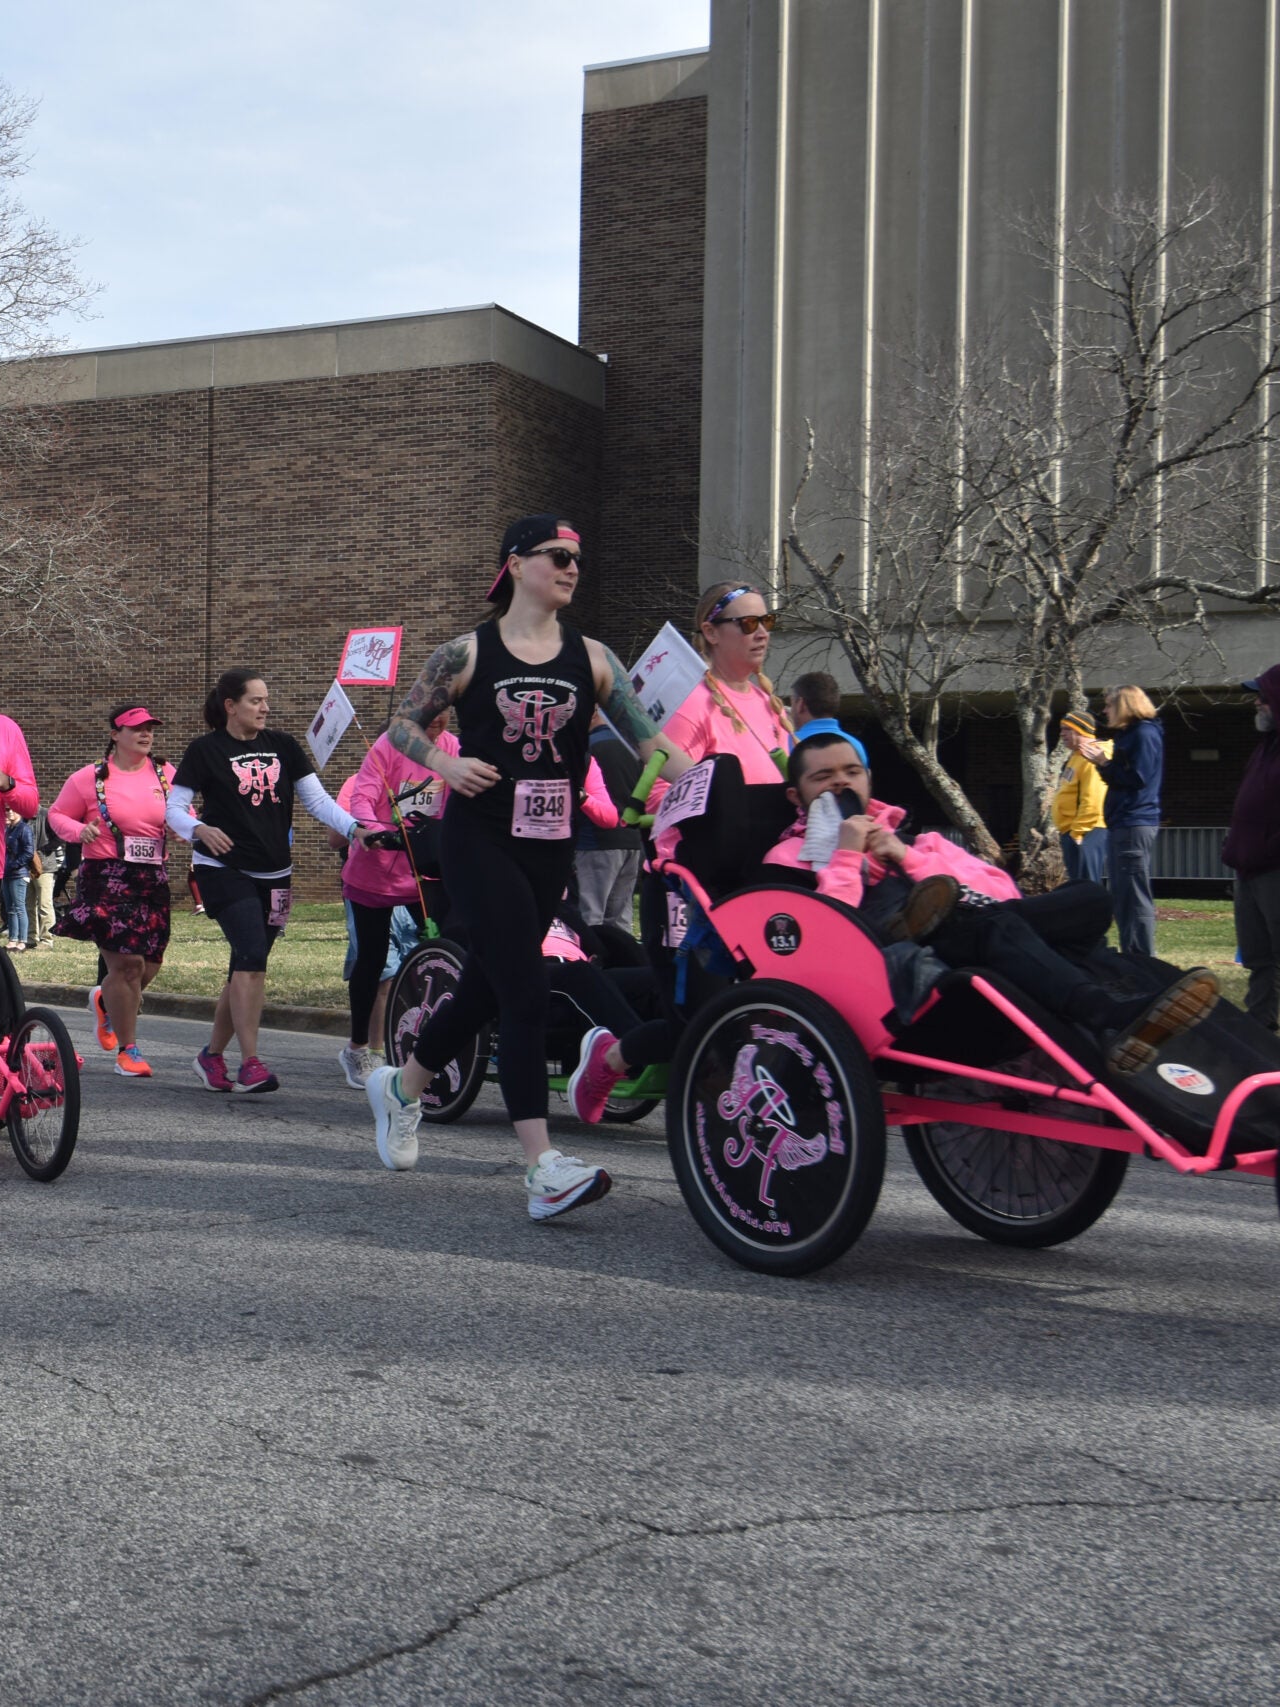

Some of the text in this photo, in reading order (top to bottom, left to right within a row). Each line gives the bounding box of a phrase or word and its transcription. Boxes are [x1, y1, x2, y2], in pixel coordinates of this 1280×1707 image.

[411, 792, 433, 806] 136
[523, 795, 565, 817] 1348
[129, 844, 155, 858] 1353
[770, 935, 797, 948] 13.1
